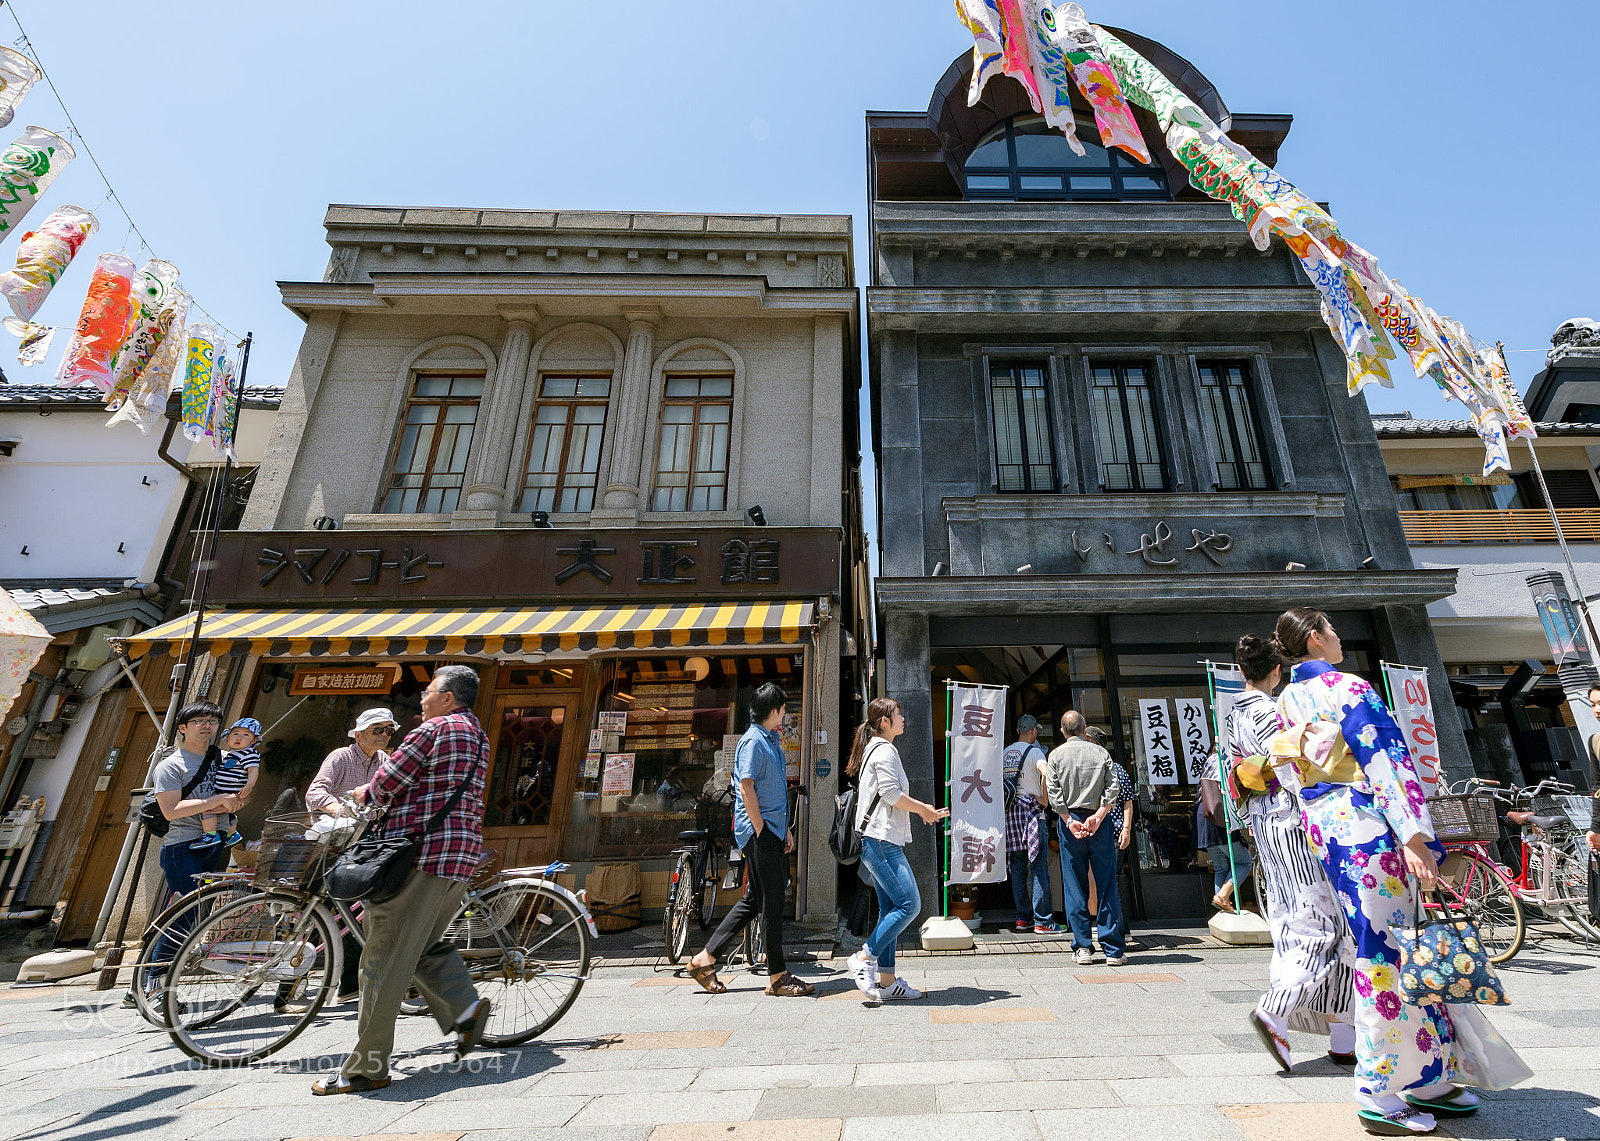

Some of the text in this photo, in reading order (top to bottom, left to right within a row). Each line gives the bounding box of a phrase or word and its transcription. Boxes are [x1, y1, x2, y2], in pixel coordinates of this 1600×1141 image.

[257, 538, 780, 587] シマノコーヒー 大正館
[1071, 520, 1234, 568] いせや
[302, 673, 385, 689] 自家焙煎珈琲
[1146, 704, 1175, 778] 豆大福
